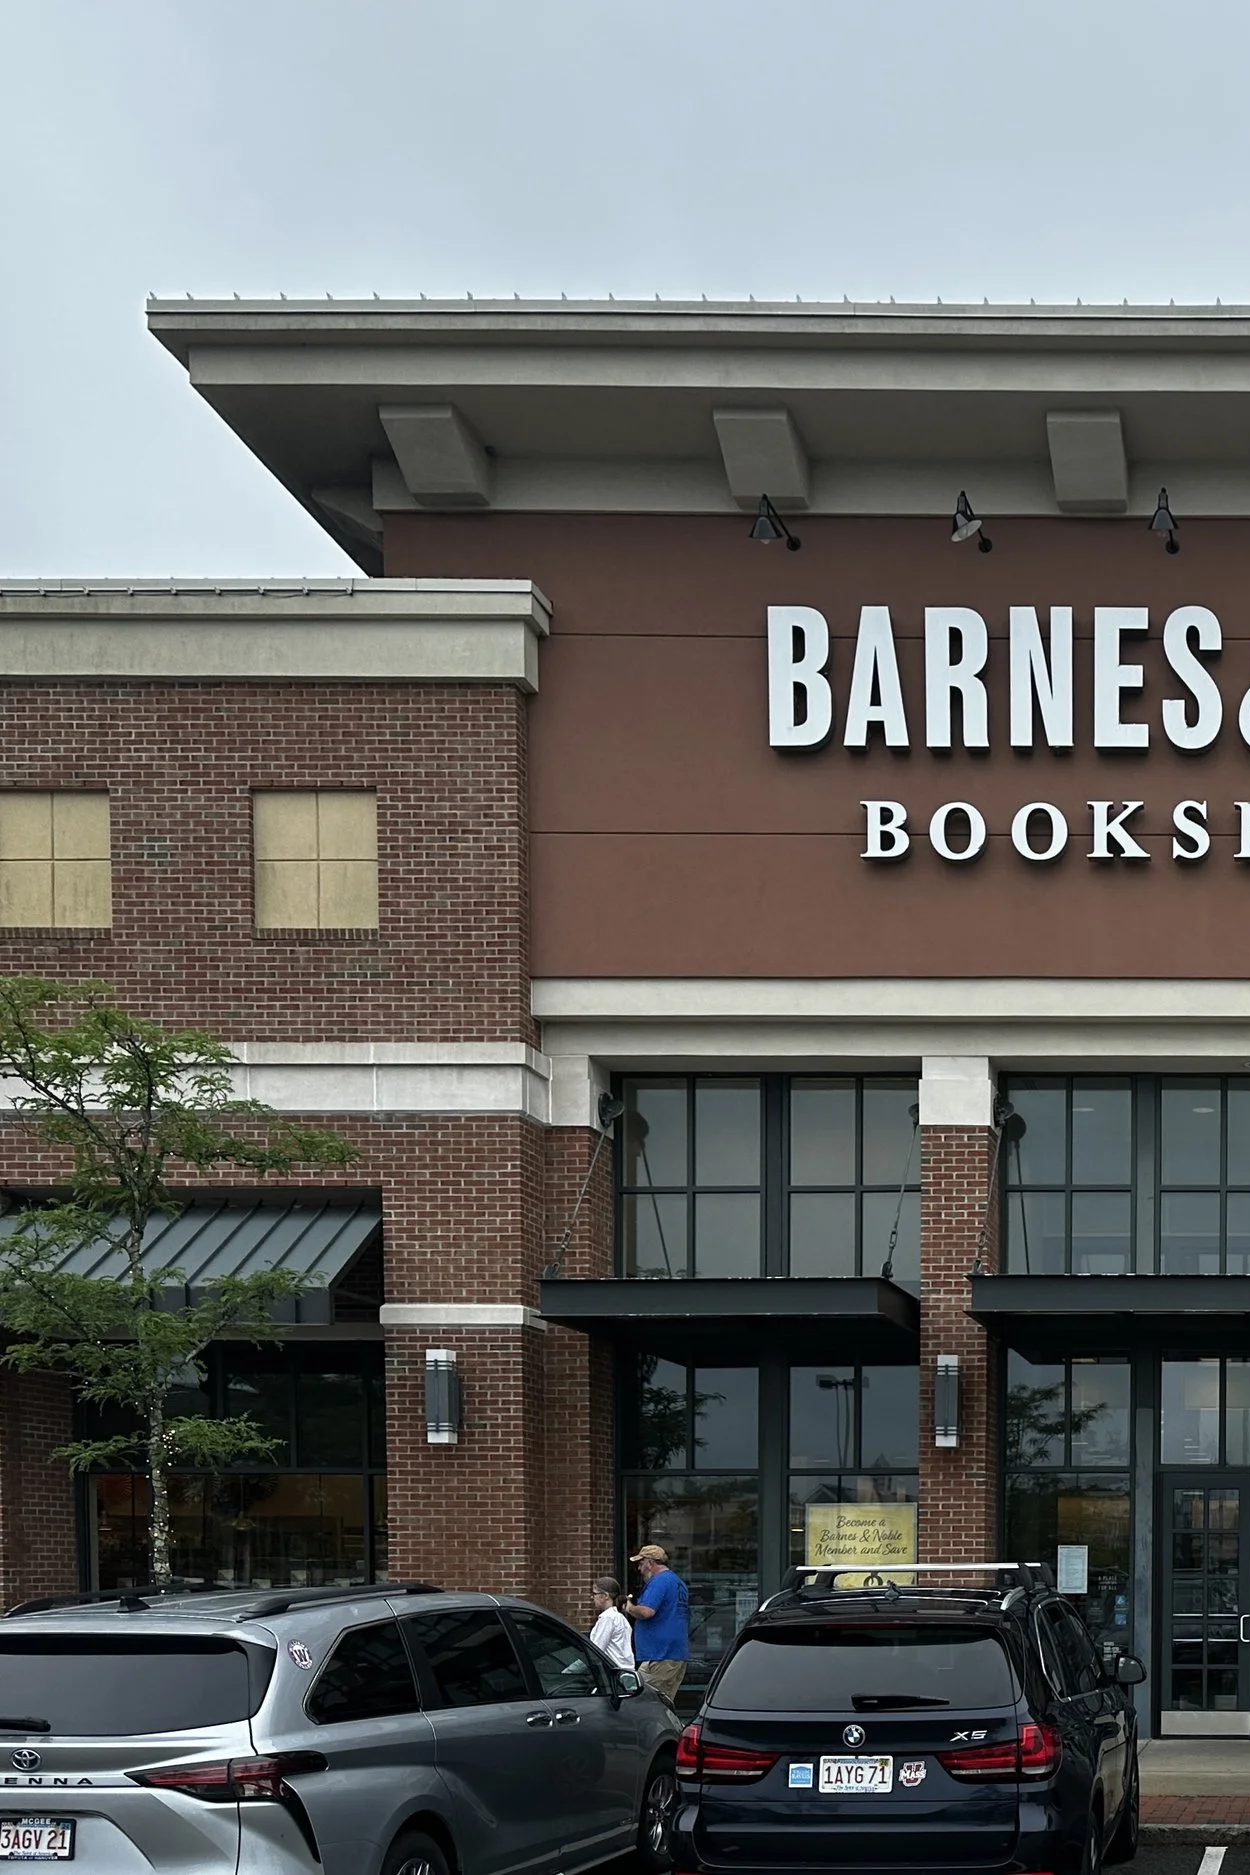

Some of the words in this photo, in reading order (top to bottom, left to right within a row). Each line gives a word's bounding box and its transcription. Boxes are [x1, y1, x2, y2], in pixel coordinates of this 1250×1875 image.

[836, 1515, 876, 1528] Become
[878, 1519, 887, 1527] a
[819, 1529, 857, 1542] Barnes
[859, 1528, 871, 1542] &
[872, 1528, 903, 1542] Noble
[815, 1543, 857, 1556] Member
[860, 1543, 882, 1555] and
[882, 1543, 908, 1556] Save
[950, 1730, 987, 1741] X5
[824, 1766, 864, 1784] 1AYG
[868, 1766, 888, 1784] 71
[900, 1770, 926, 1780] MASS
[1, 1829, 43, 1850] 3AGV
[47, 1829, 67, 1850] 21
